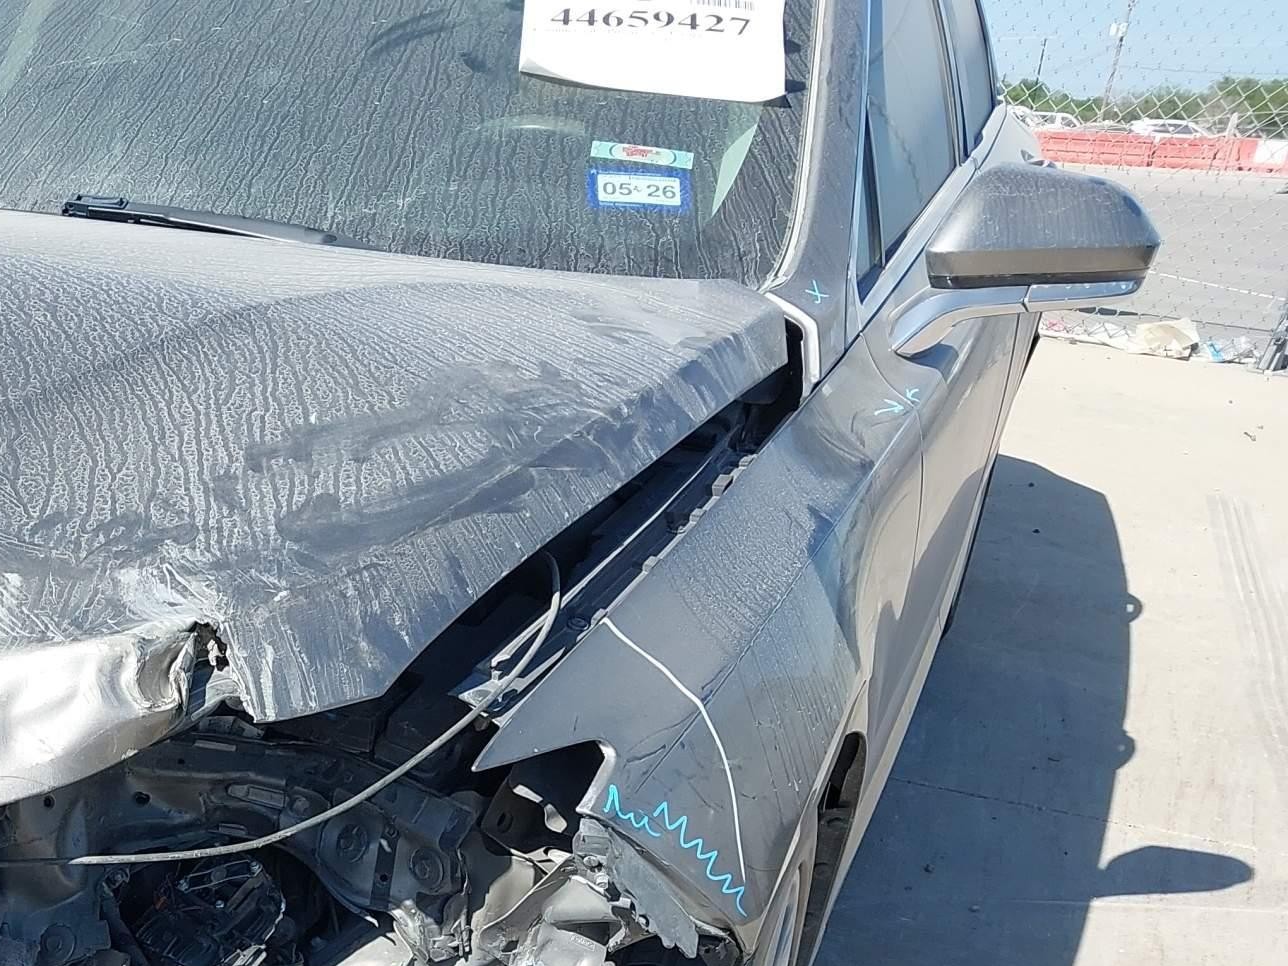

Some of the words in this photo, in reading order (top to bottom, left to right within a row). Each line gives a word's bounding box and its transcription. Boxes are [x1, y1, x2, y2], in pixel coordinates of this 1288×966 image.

[550, 8, 751, 36] 44659427
[602, 181, 633, 196] 05
[645, 184, 677, 199] 26
